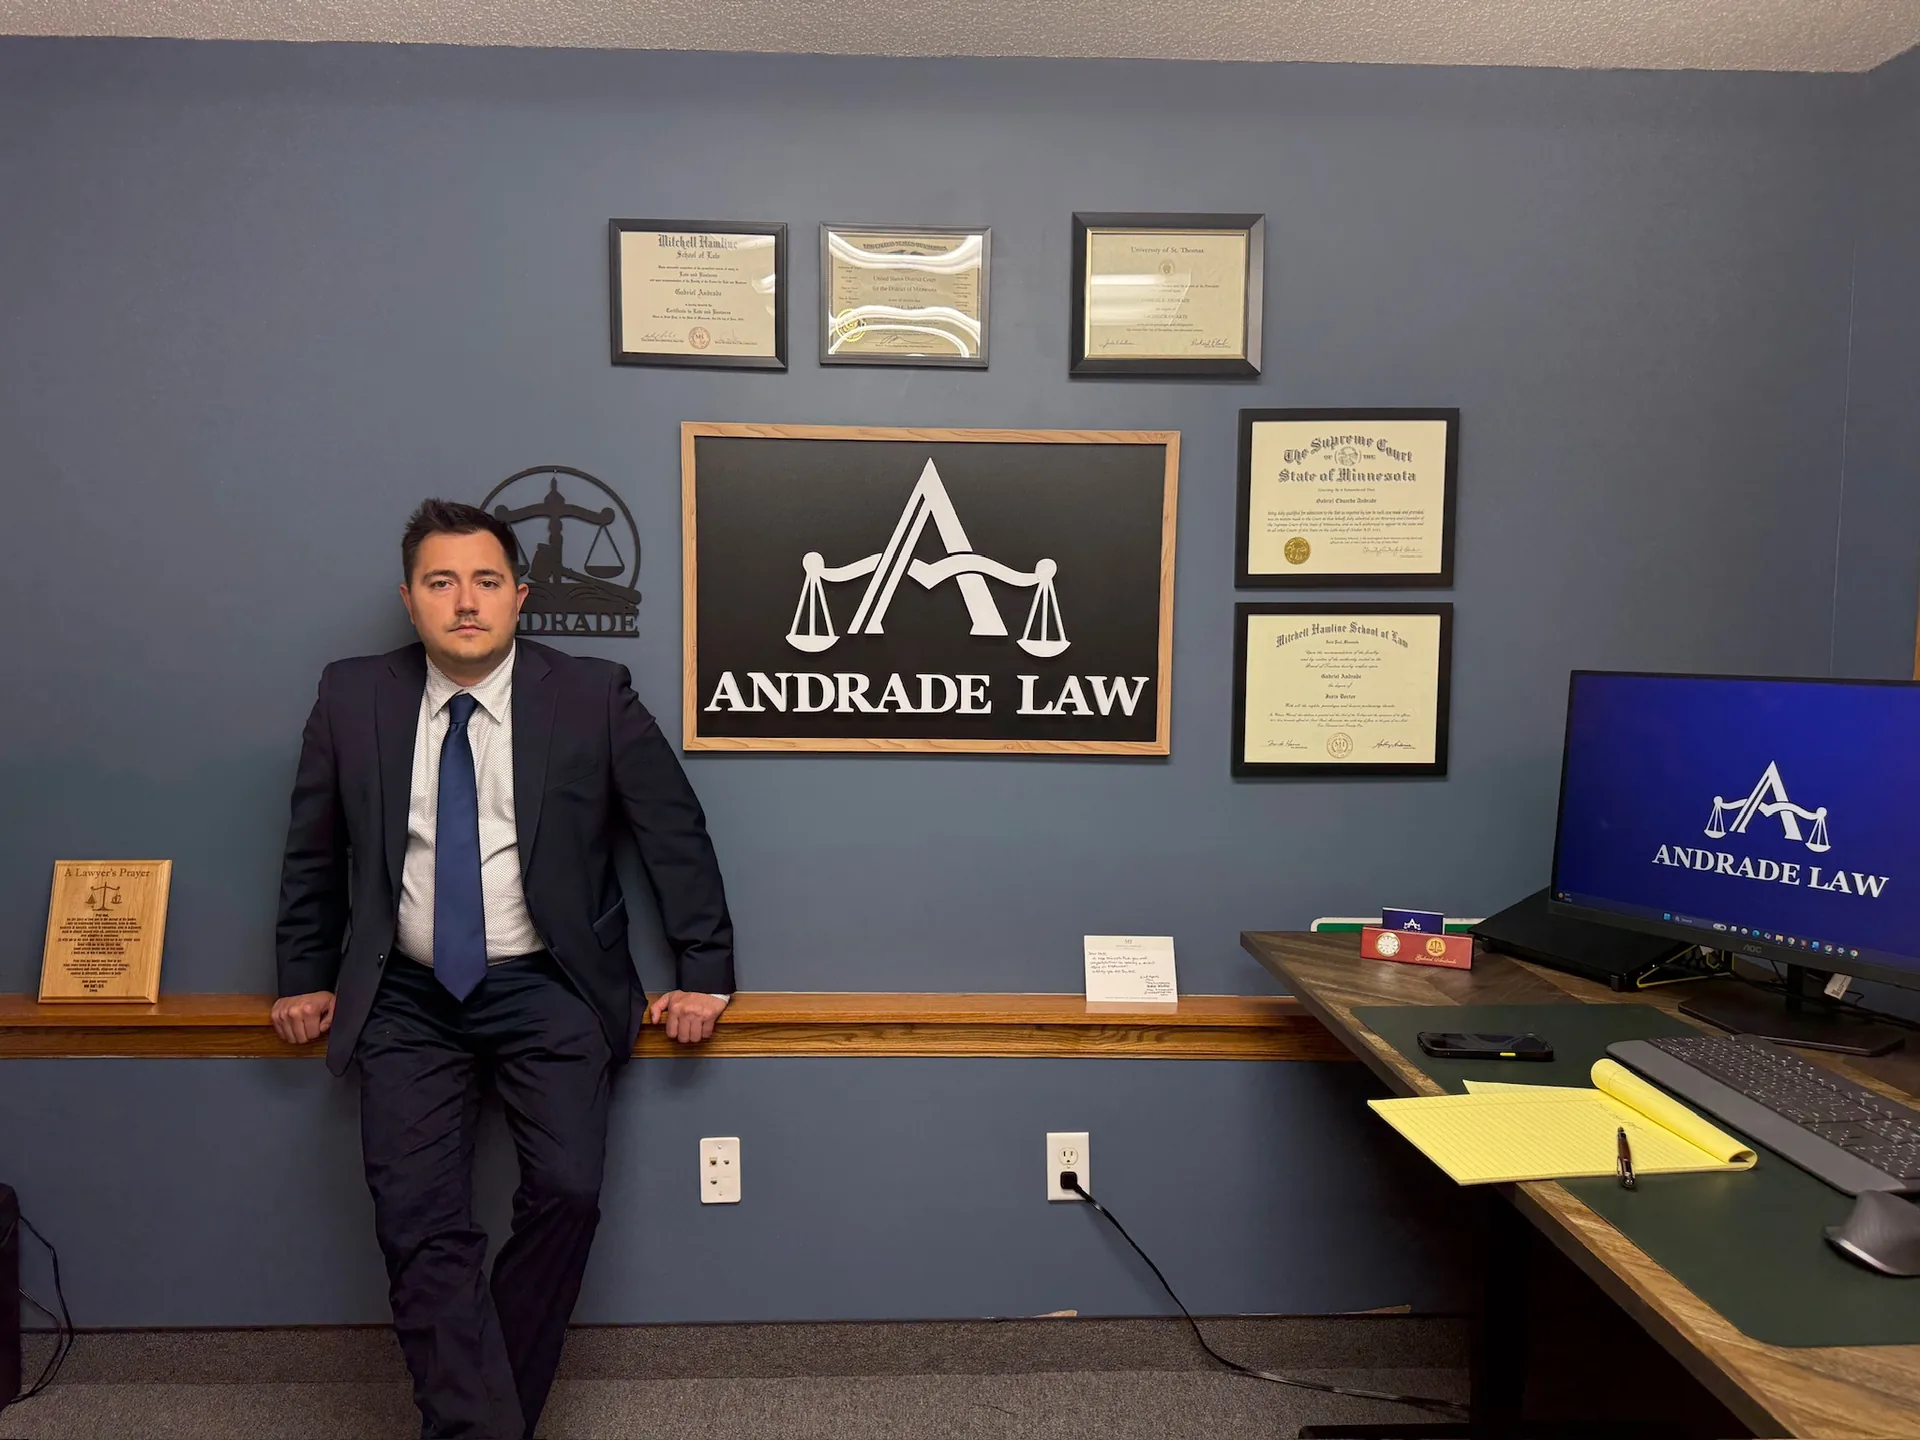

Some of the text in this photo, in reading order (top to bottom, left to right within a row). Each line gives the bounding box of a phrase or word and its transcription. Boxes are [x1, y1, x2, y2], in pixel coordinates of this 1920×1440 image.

[658, 234, 696, 250] Mitchell
[1131, 246, 1160, 254] University
[676, 250, 696, 260] School
[1284, 435, 1413, 465] The Supreme Court
[1278, 468, 1416, 483] State of Minnesota
[1276, 621, 1408, 648] Mitchell Hamline School of Law
[704, 671, 1150, 717] ANDRADE LAW
[64, 868, 150, 879] A Lawyer's Prayer
[1652, 844, 1890, 898] ANDRADE LAW
